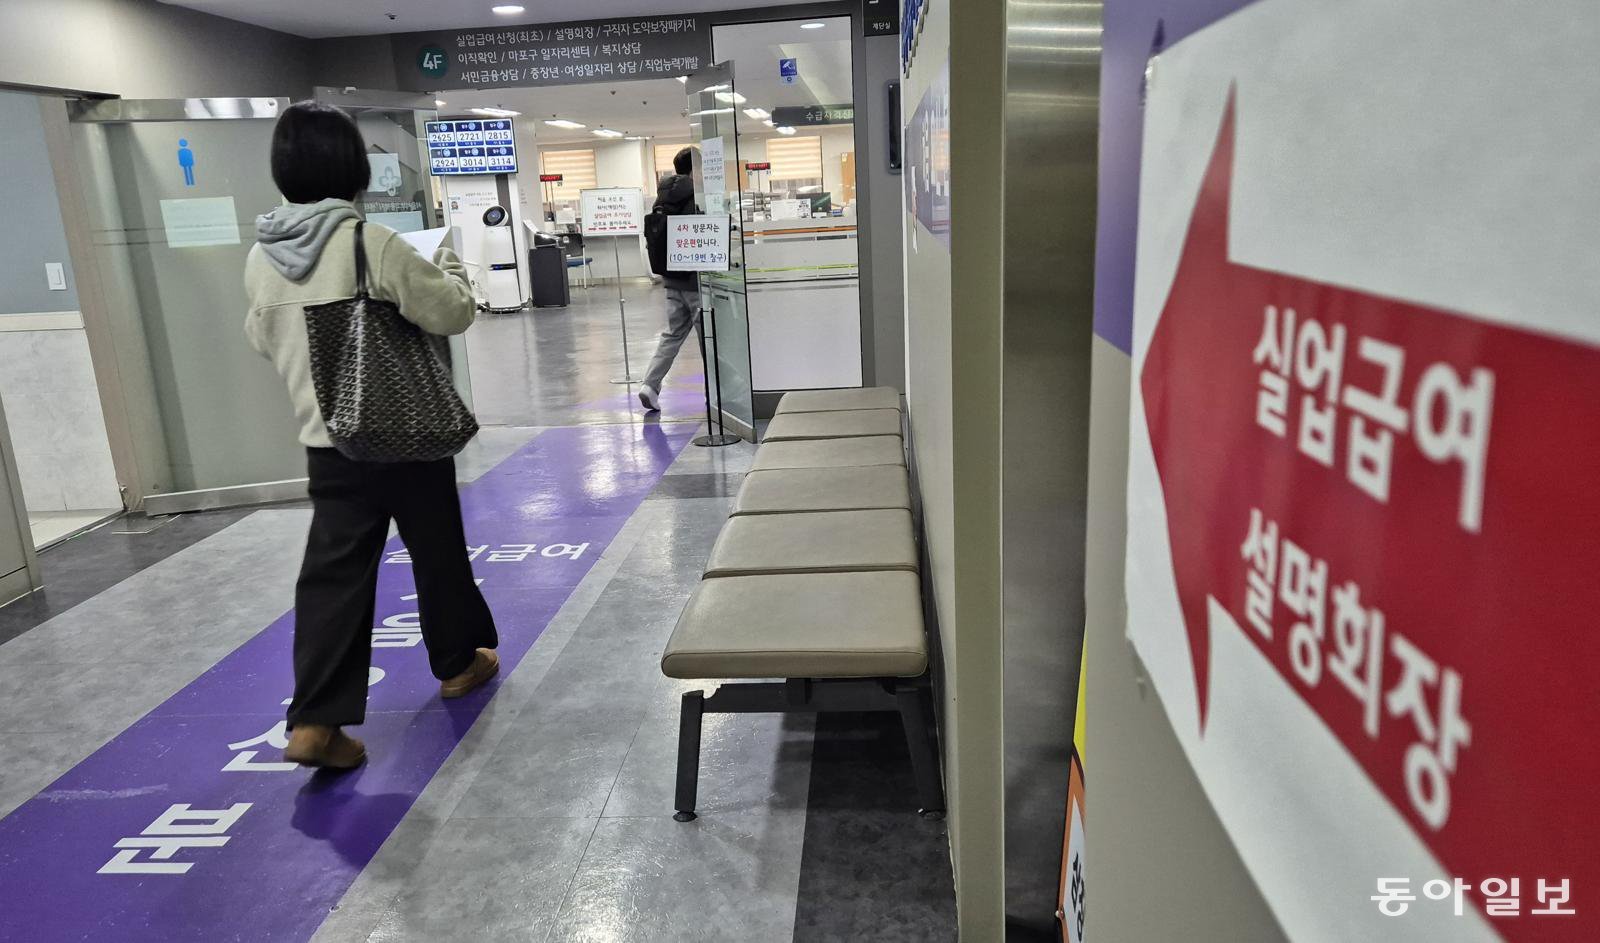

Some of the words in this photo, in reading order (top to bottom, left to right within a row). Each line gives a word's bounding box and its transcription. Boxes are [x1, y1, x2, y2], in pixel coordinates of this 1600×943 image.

[554, 27, 594, 41] 설명회장
[602, 23, 630, 37] 구직자
[423, 52, 442, 70] 4F
[458, 51, 497, 64] 이직확인
[508, 48, 538, 62] 마포구
[541, 44, 590, 60] 일자리센터
[602, 42, 641, 56] 복지상담
[460, 68, 519, 83] 서민금융상담
[617, 60, 637, 74] 상담
[460, 132, 480, 141] 2721
[488, 131, 509, 140] 2815
[463, 158, 483, 167] 3014
[491, 157, 511, 166] 3114
[677, 223, 689, 232] 4차
[692, 223, 720, 234] 방문자는
[1252, 304, 1496, 534] 실업급여
[383, 542, 590, 564] 실급여
[1240, 507, 1473, 832] 설명회장
